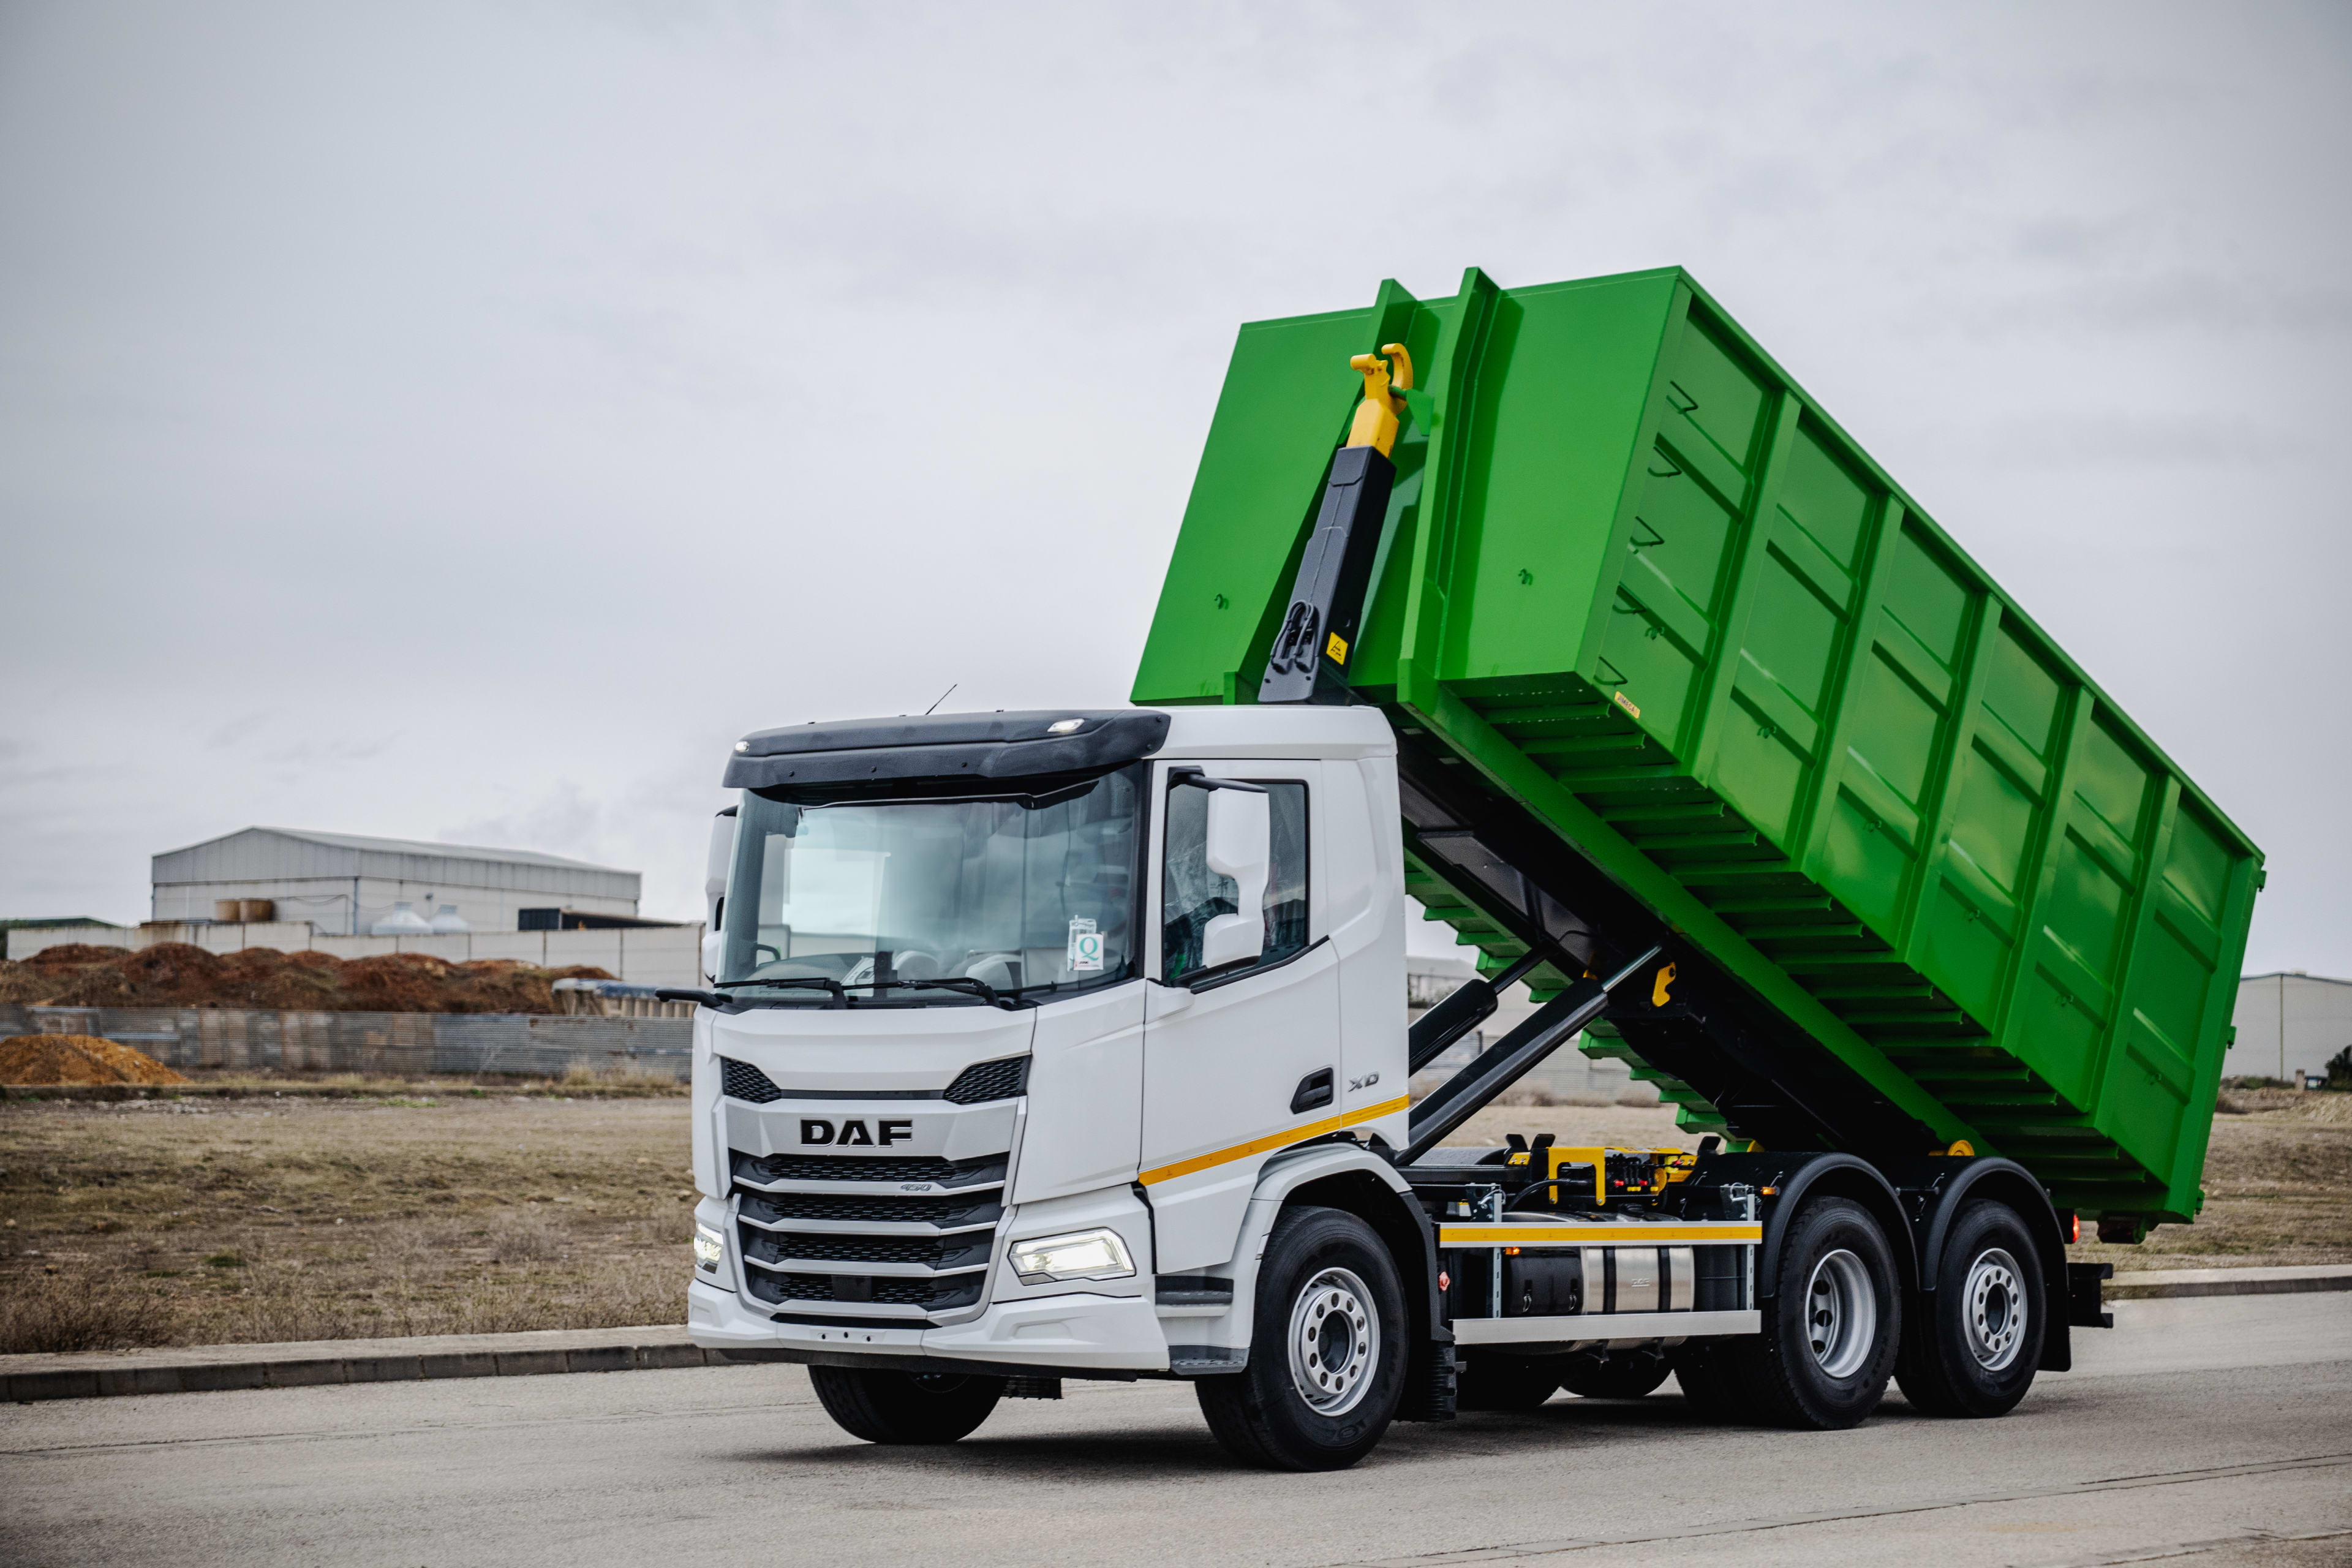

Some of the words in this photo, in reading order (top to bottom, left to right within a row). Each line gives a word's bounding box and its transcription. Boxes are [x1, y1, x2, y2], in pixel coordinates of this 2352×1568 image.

[1079, 937, 1099, 961] Q
[1348, 1072, 1379, 1093] XD
[801, 1118, 913, 1147] DAF
[900, 1183, 932, 1192] 450
